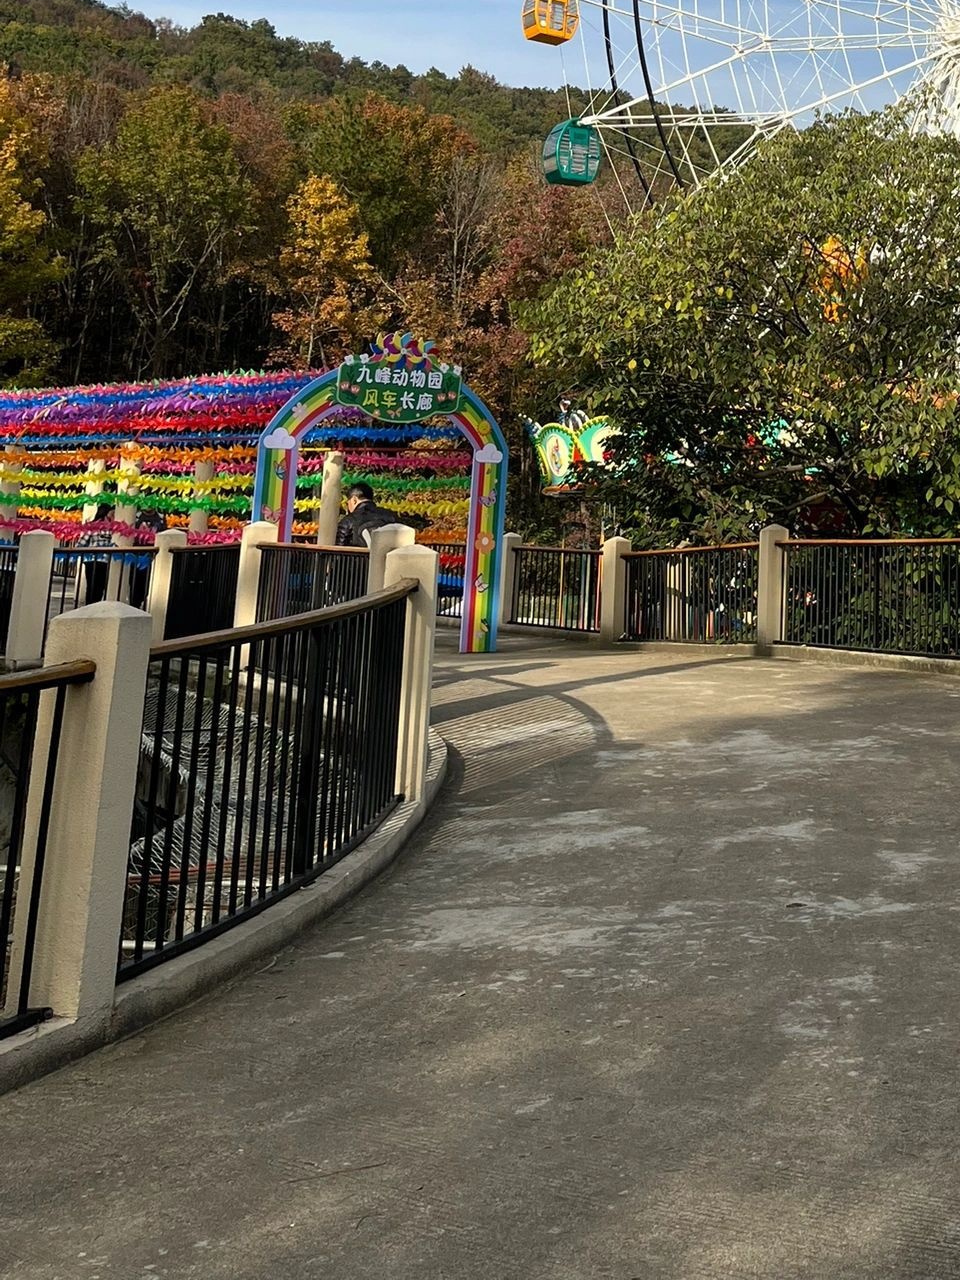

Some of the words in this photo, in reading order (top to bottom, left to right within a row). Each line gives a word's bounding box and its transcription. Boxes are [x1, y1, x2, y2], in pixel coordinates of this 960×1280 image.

[356, 365, 443, 389] 九峰动物园
[362, 389, 433, 411] 风车长廊
